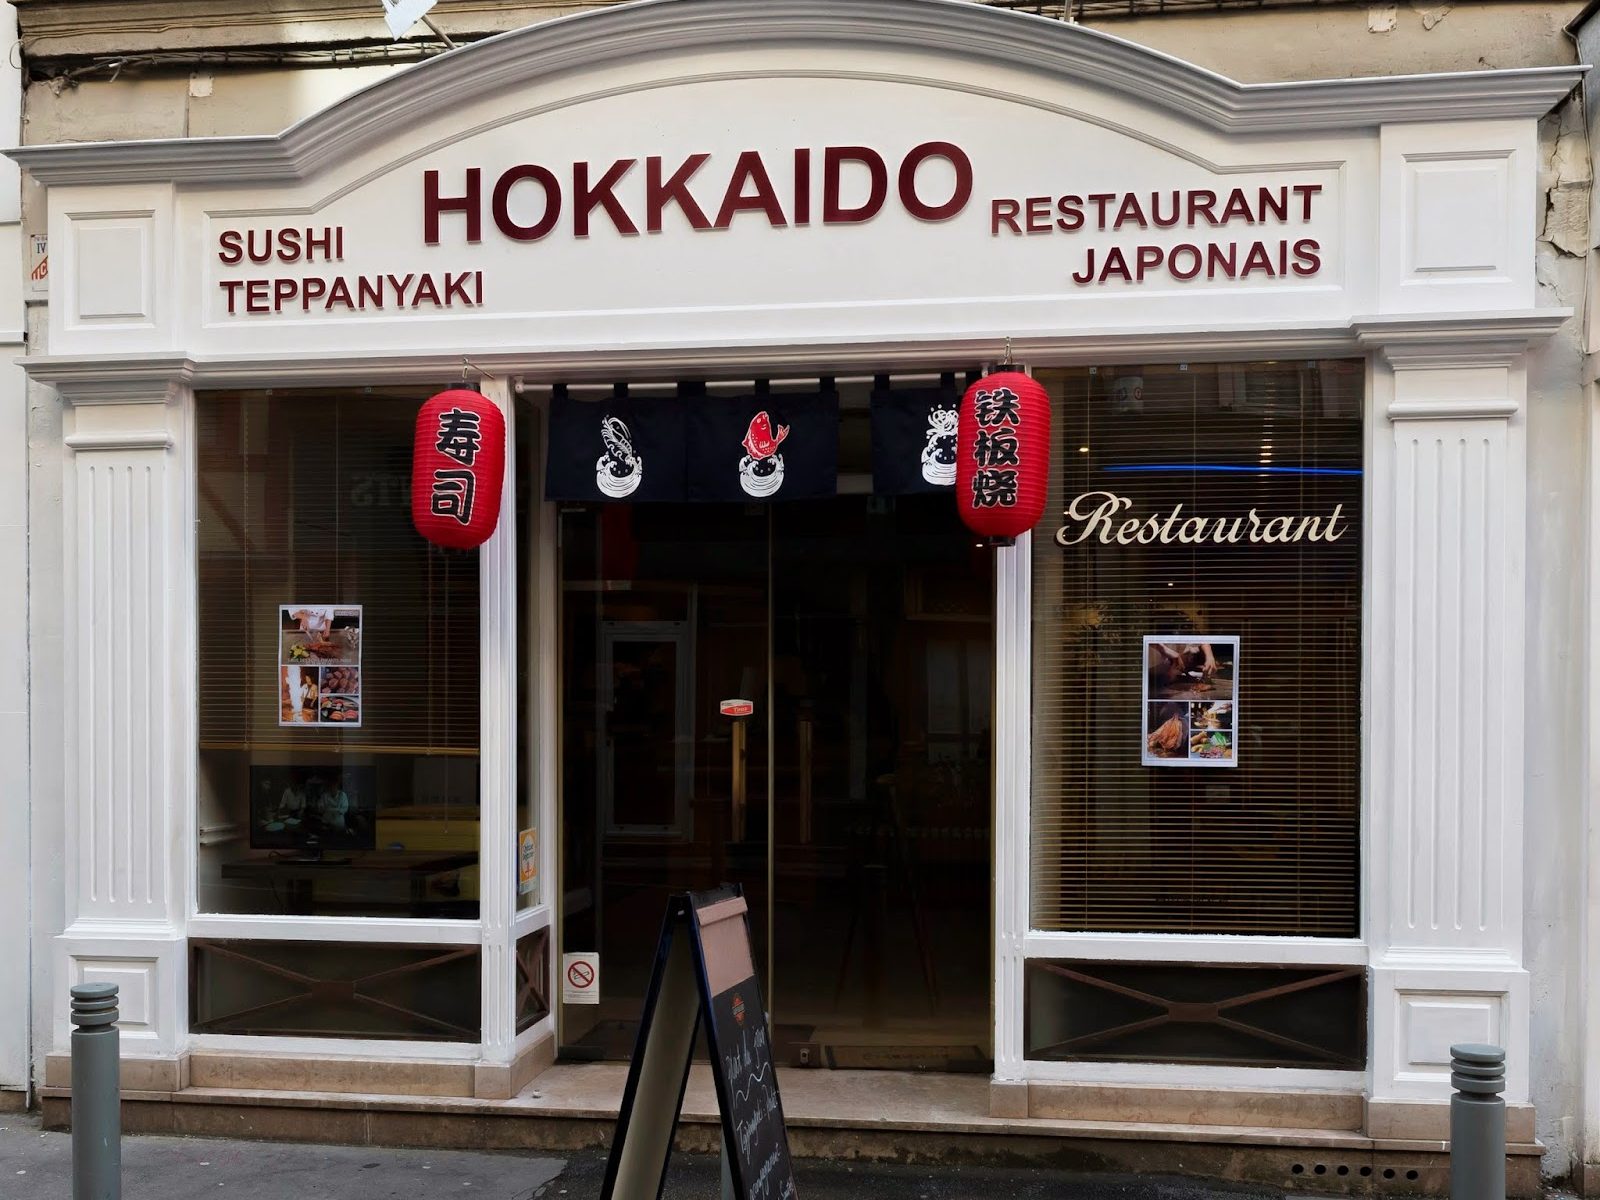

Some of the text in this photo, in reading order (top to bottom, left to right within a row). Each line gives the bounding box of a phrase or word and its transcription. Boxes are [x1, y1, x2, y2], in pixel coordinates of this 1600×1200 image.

[424, 141, 973, 245] HOKKAIDO
[991, 184, 1321, 235] RESTAURANT
[218, 226, 344, 265] SUSHI
[1073, 239, 1321, 284] JAPONAIS
[220, 271, 484, 314] TEPPANYAKI
[431, 407, 481, 525] 寿司
[1056, 491, 1348, 545] Restaurant
